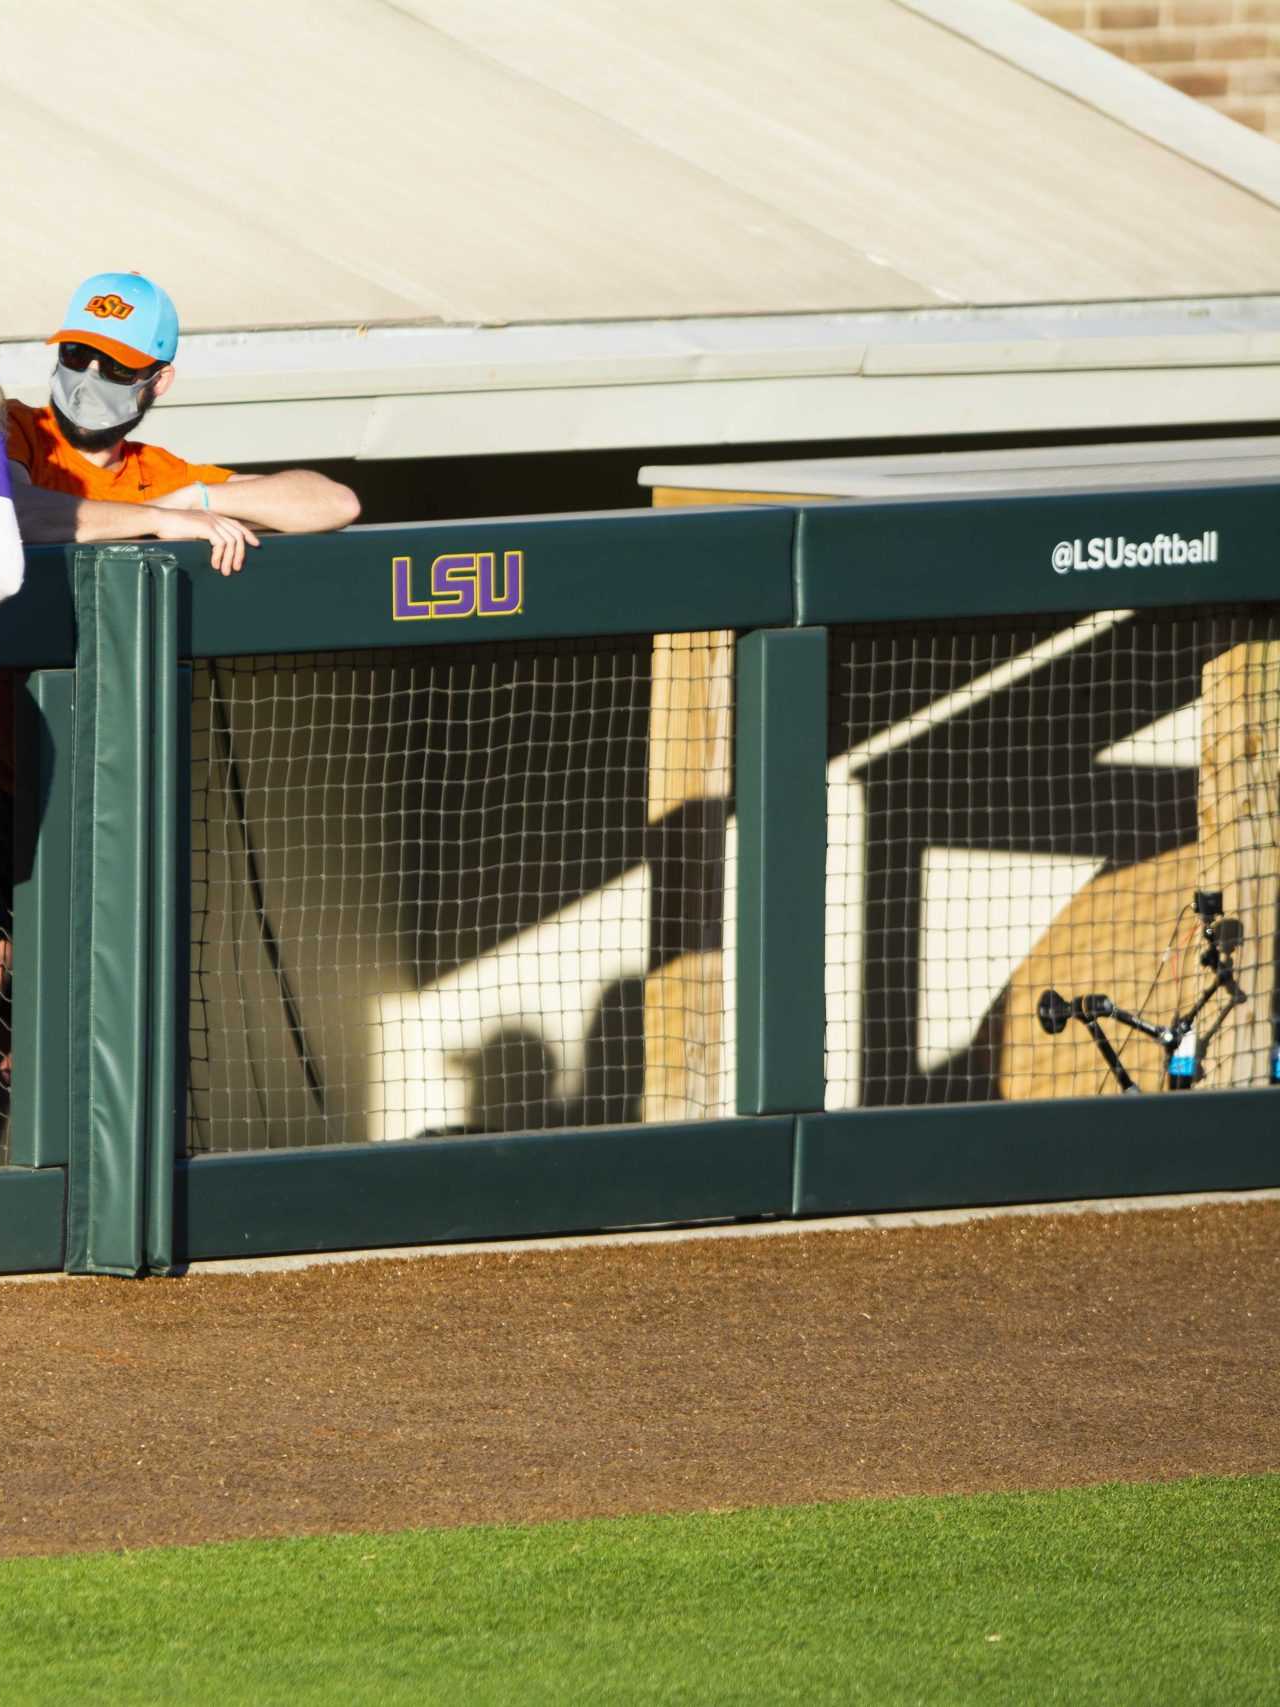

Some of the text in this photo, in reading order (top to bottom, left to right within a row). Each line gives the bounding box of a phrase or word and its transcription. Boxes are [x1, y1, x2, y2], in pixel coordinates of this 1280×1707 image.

[84, 294, 134, 320] OSU
[1051, 531, 1218, 574] @LSUsoftball
[392, 551, 523, 621] LSU
